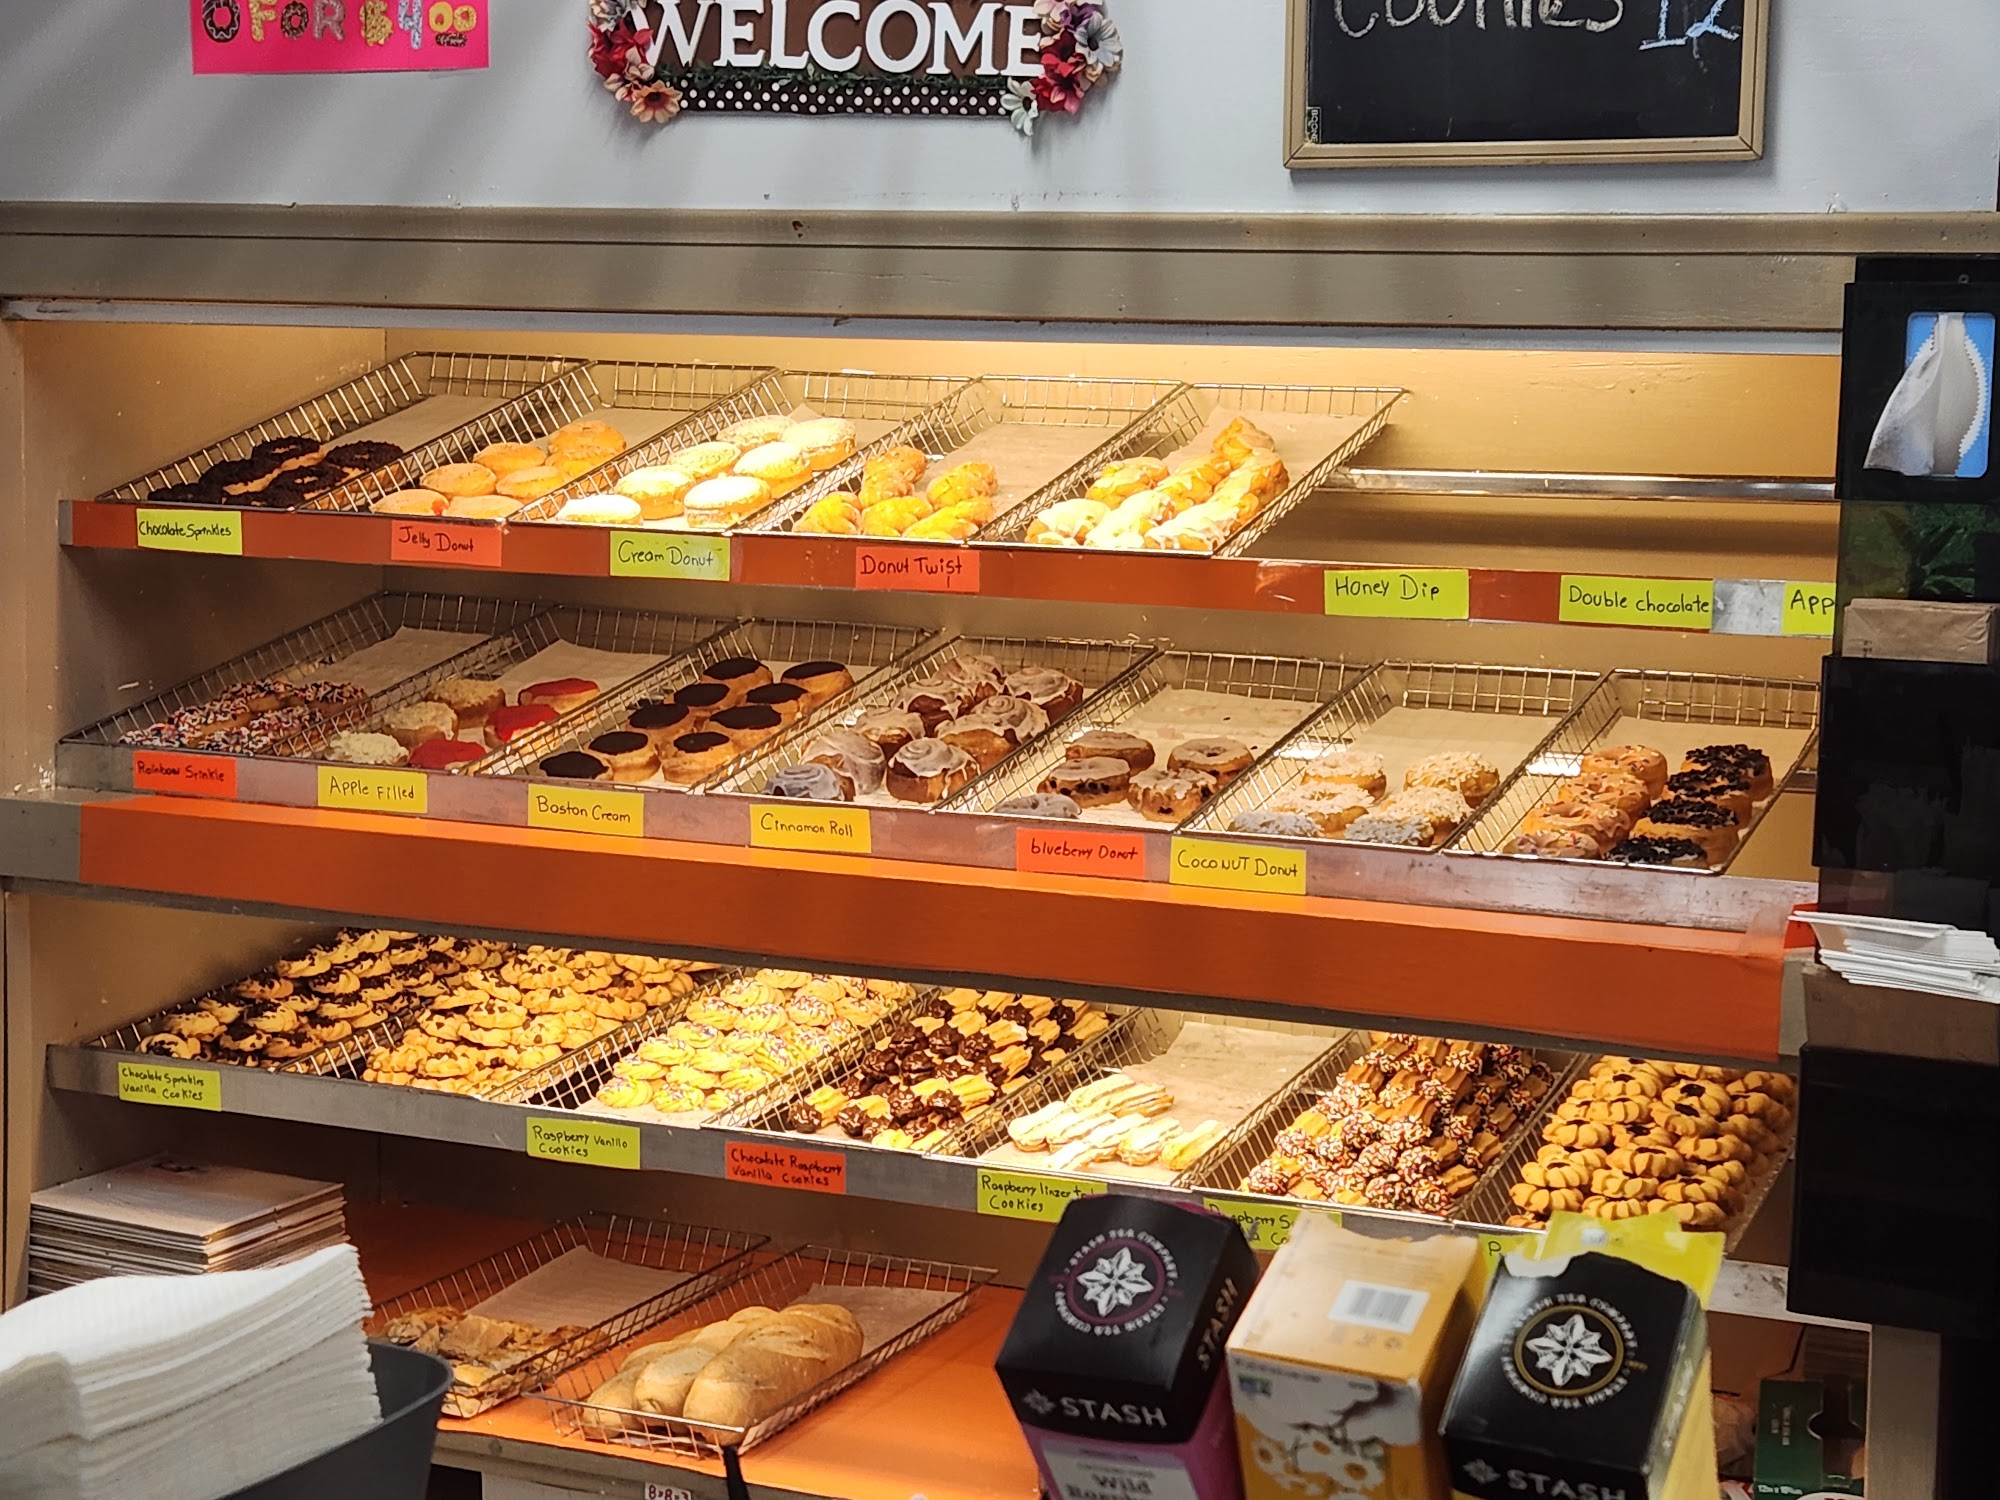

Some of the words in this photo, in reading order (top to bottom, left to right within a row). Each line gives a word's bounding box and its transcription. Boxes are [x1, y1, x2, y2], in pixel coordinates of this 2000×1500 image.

[249, 0, 346, 41] FOR
[632, 0, 1042, 77] WELCOME
[138, 520, 187, 536] Chocolate
[186, 523, 232, 541] Sprinkles
[398, 526, 431, 549] Jelly
[434, 532, 475, 552] Donut
[618, 540, 665, 565] Cream
[667, 545, 714, 567] Donut
[861, 554, 909, 575] Donut
[914, 555, 963, 575] Twist
[1335, 575, 1390, 597] Honey
[1399, 574, 1440, 601] Dip
[1569, 584, 1628, 609] Double
[1790, 589, 1835, 615] App
[136, 760, 180, 776] Rainbow
[329, 775, 370, 796] Apple
[377, 784, 415, 800] Filled
[536, 794, 588, 818] Boston
[591, 804, 631, 824] Cream
[760, 812, 826, 835] Cinnamon
[829, 821, 854, 838] Roll
[1098, 844, 1138, 860] Donut
[1254, 857, 1298, 877] Donut
[121, 1067, 162, 1082] Chocolate
[122, 1083, 157, 1095] Vanilla
[162, 1088, 203, 1101] Cookies
[532, 1125, 590, 1145] Raspberry
[593, 1135, 628, 1148] Vanilla
[538, 1142, 589, 1157] Cookies
[730, 1147, 785, 1167] Chocolate
[789, 1155, 842, 1176] Raspberry
[732, 1165, 773, 1180] Vanilla
[782, 1172, 829, 1186] Cookies
[981, 1174, 1037, 1197] Raspberry
[989, 1194, 1044, 1212] Cookies
[1198, 1277, 1239, 1372] STASH
[1060, 1396, 1168, 1429] STASH
[1507, 1469, 1626, 1500] STASH
